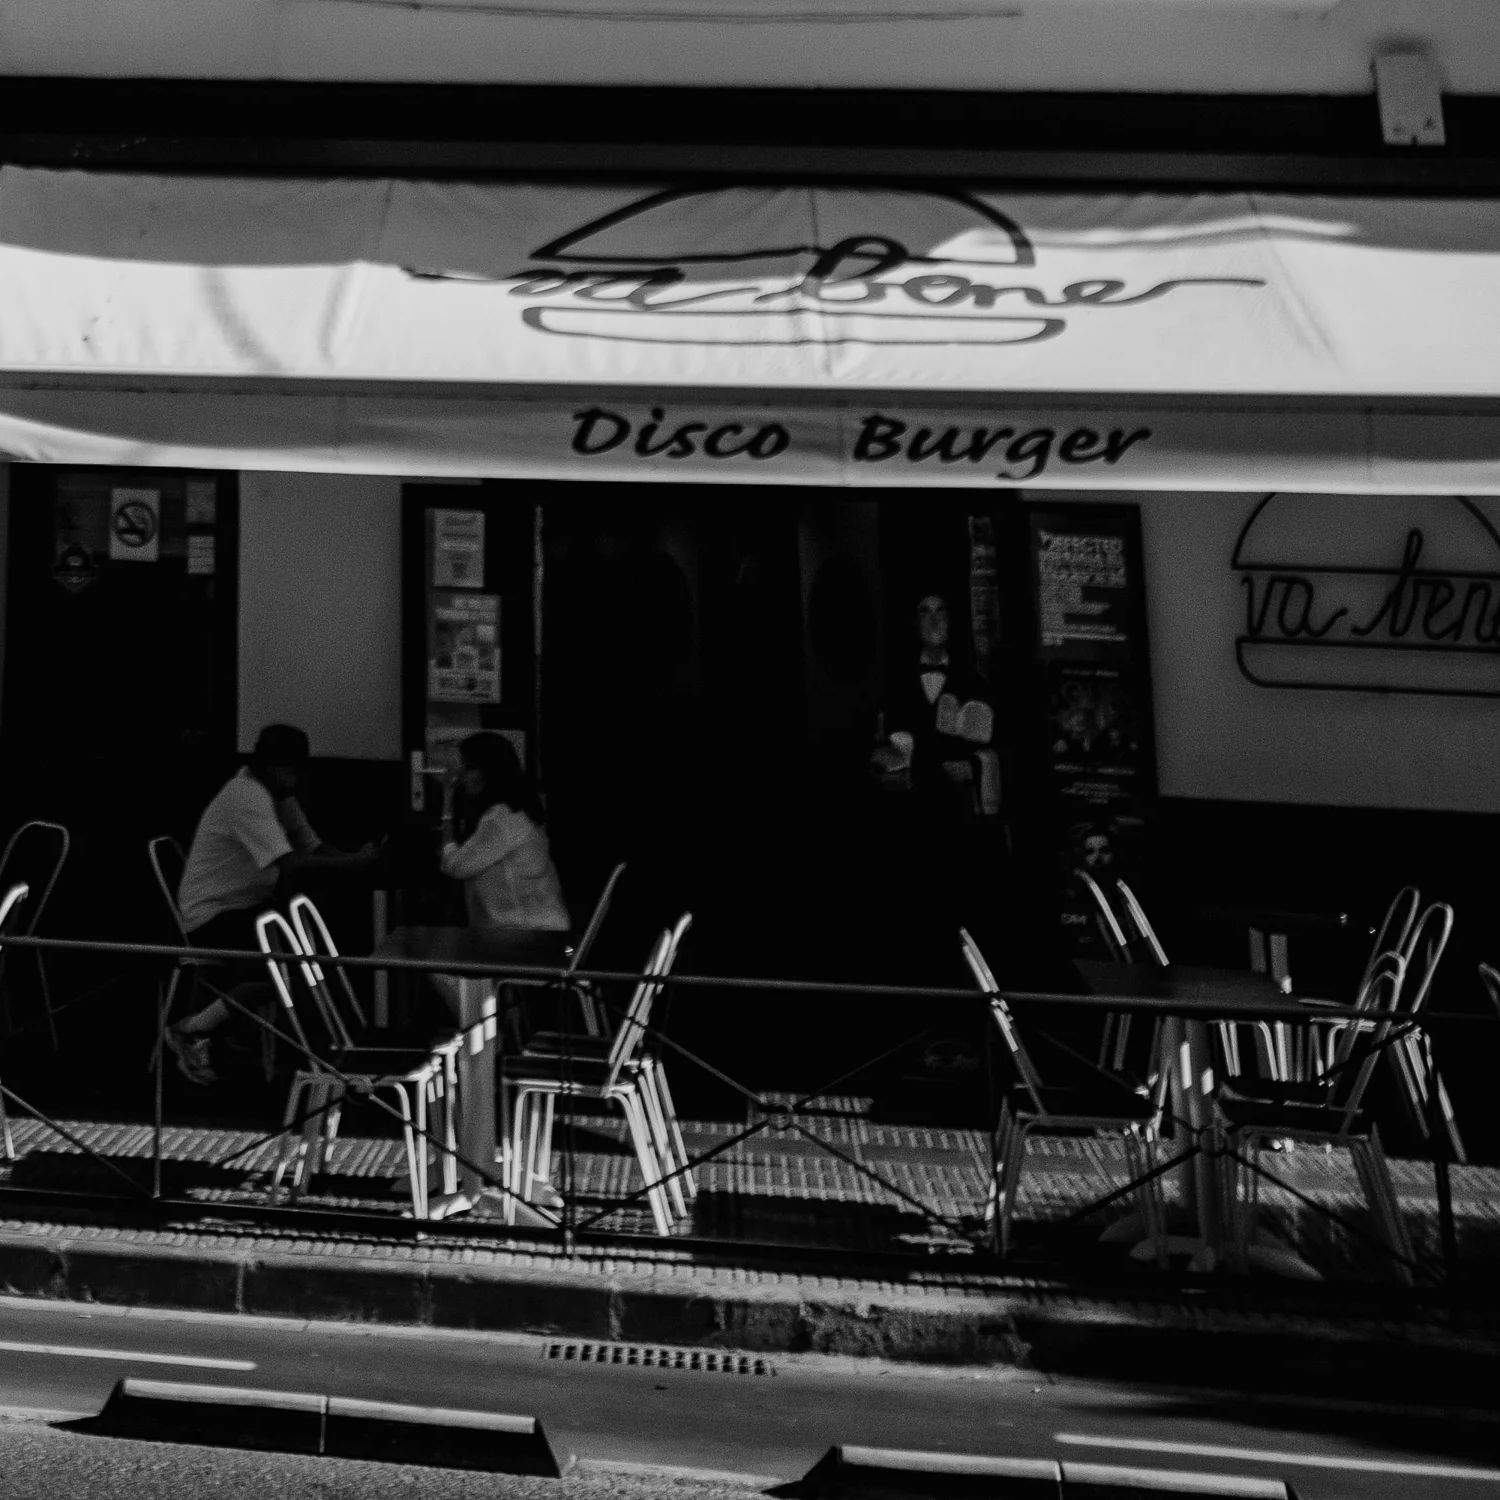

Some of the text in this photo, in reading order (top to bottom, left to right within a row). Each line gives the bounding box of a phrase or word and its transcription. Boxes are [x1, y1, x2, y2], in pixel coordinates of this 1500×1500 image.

[572, 406, 1152, 481] Disco Burger
[1242, 526, 1500, 644] va ben
